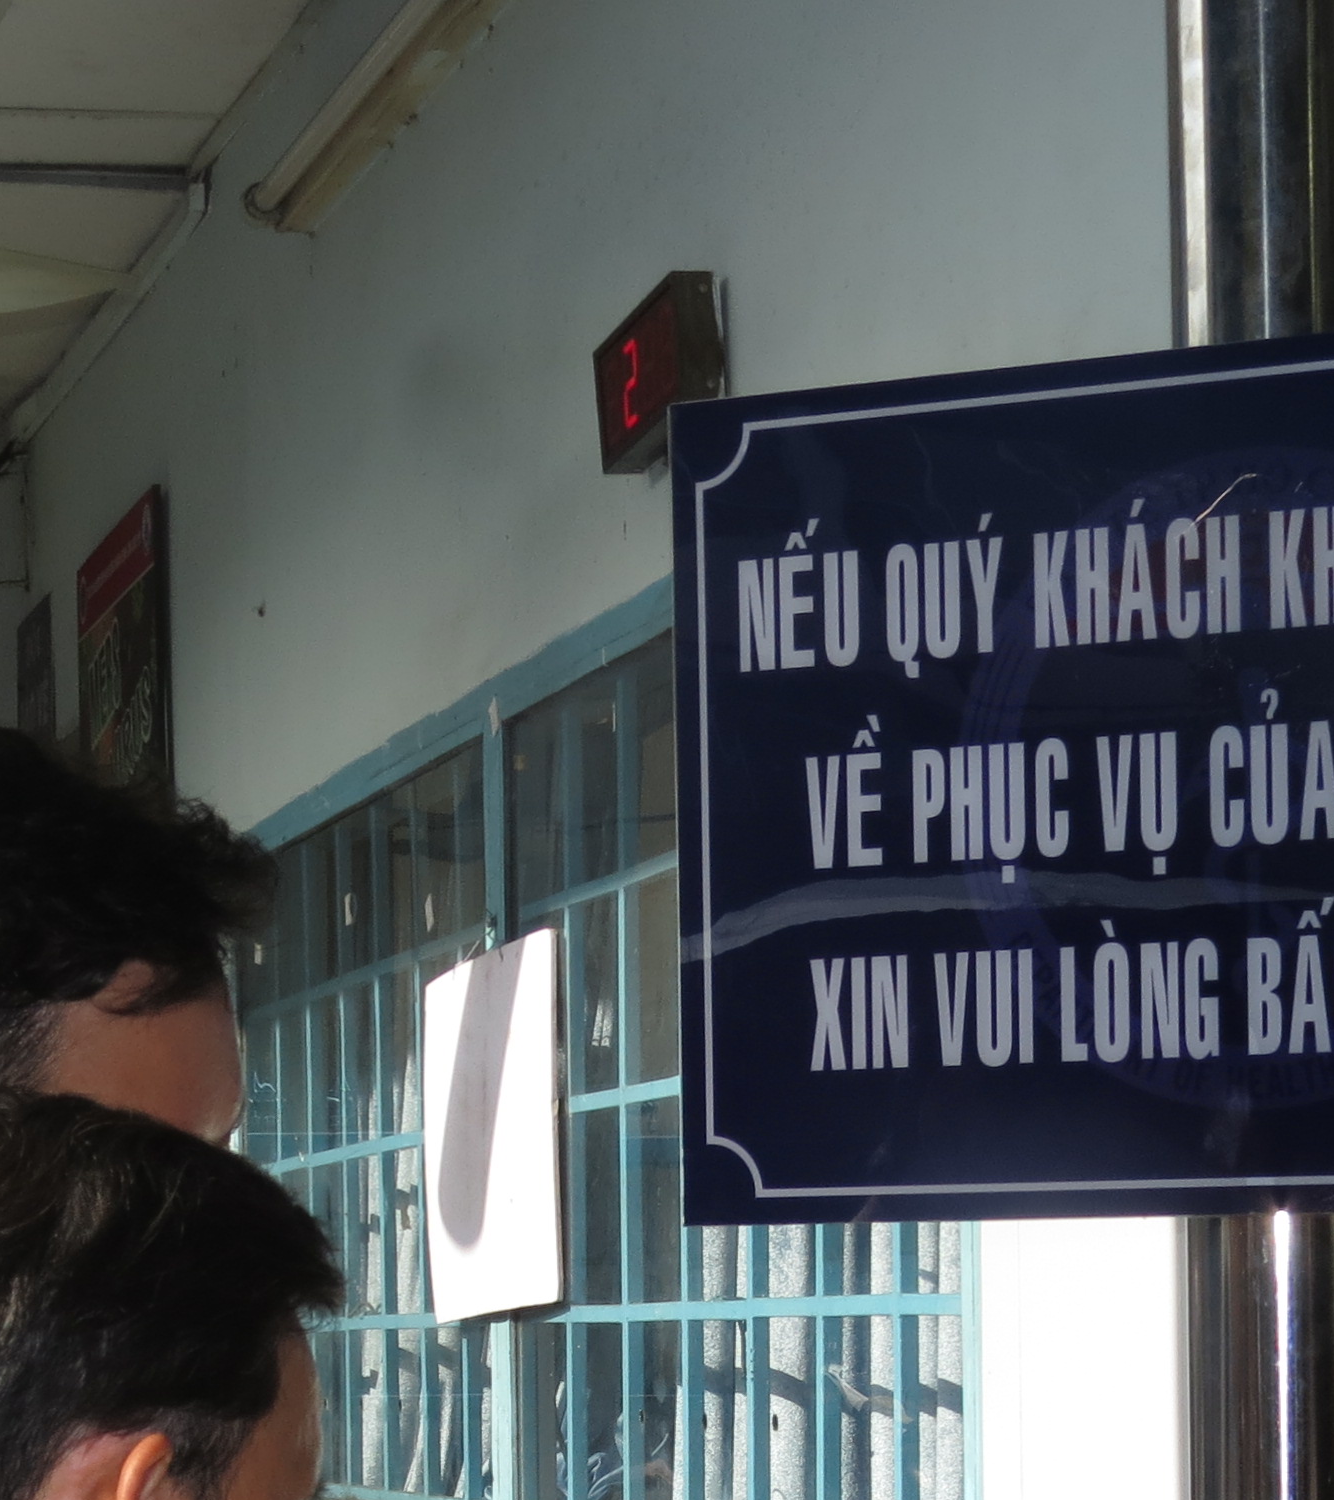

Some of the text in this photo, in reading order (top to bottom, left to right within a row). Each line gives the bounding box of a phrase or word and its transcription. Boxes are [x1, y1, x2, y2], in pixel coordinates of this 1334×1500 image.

[622, 338, 640, 429] 2
[737, 518, 860, 674] NẾU
[885, 513, 1003, 679] QUÝ
[1033, 498, 1241, 649] KHÁCH
[805, 715, 883, 870] VỀ
[912, 738, 1070, 884] PHỤC
[1096, 732, 1178, 875] VỤ
[809, 954, 909, 1072] XIN
[933, 948, 1034, 1067] VUI
[1059, 919, 1220, 1063] LÒNG
